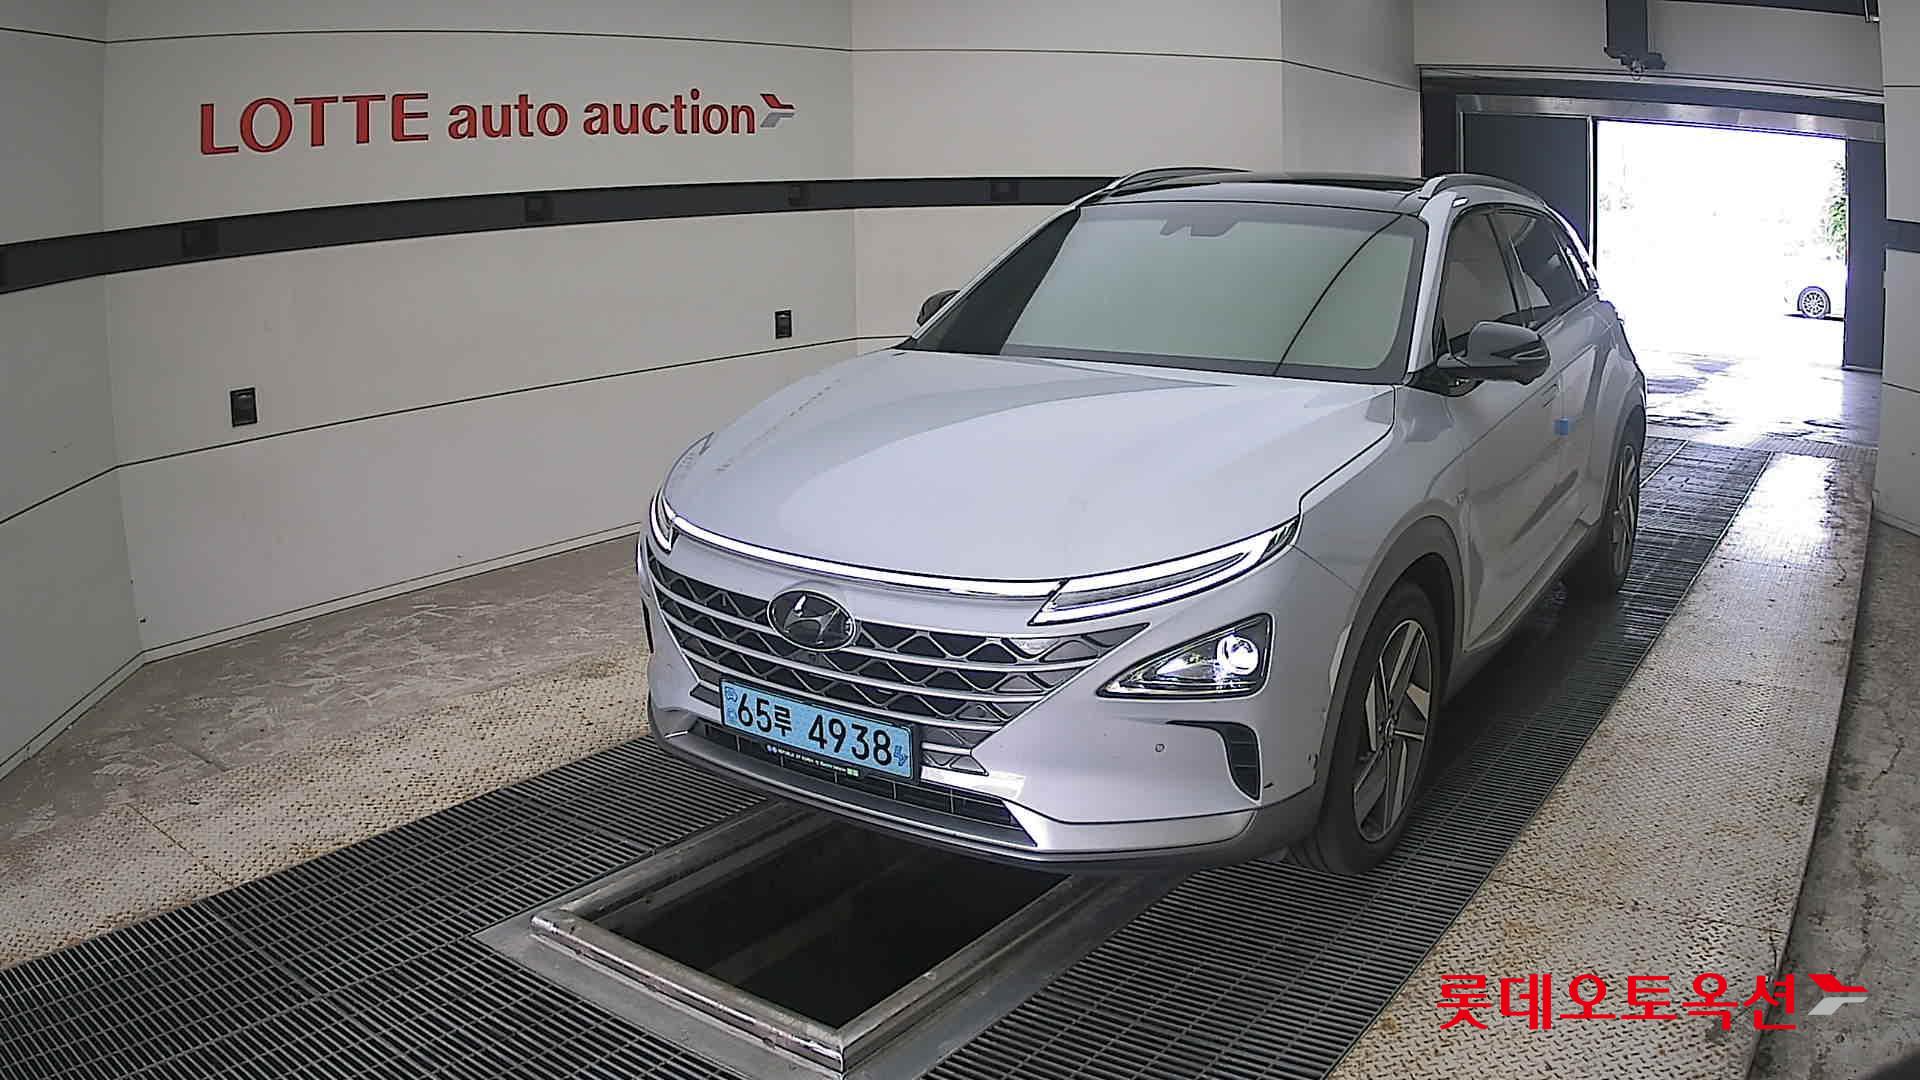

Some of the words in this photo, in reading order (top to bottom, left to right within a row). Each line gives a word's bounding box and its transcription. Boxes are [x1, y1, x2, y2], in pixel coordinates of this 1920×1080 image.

[200, 93, 429, 155] LOTTE
[448, 94, 568, 139] auto
[583, 89, 756, 135] auction
[737, 693, 792, 737] 65루
[808, 714, 892, 766] 4938
